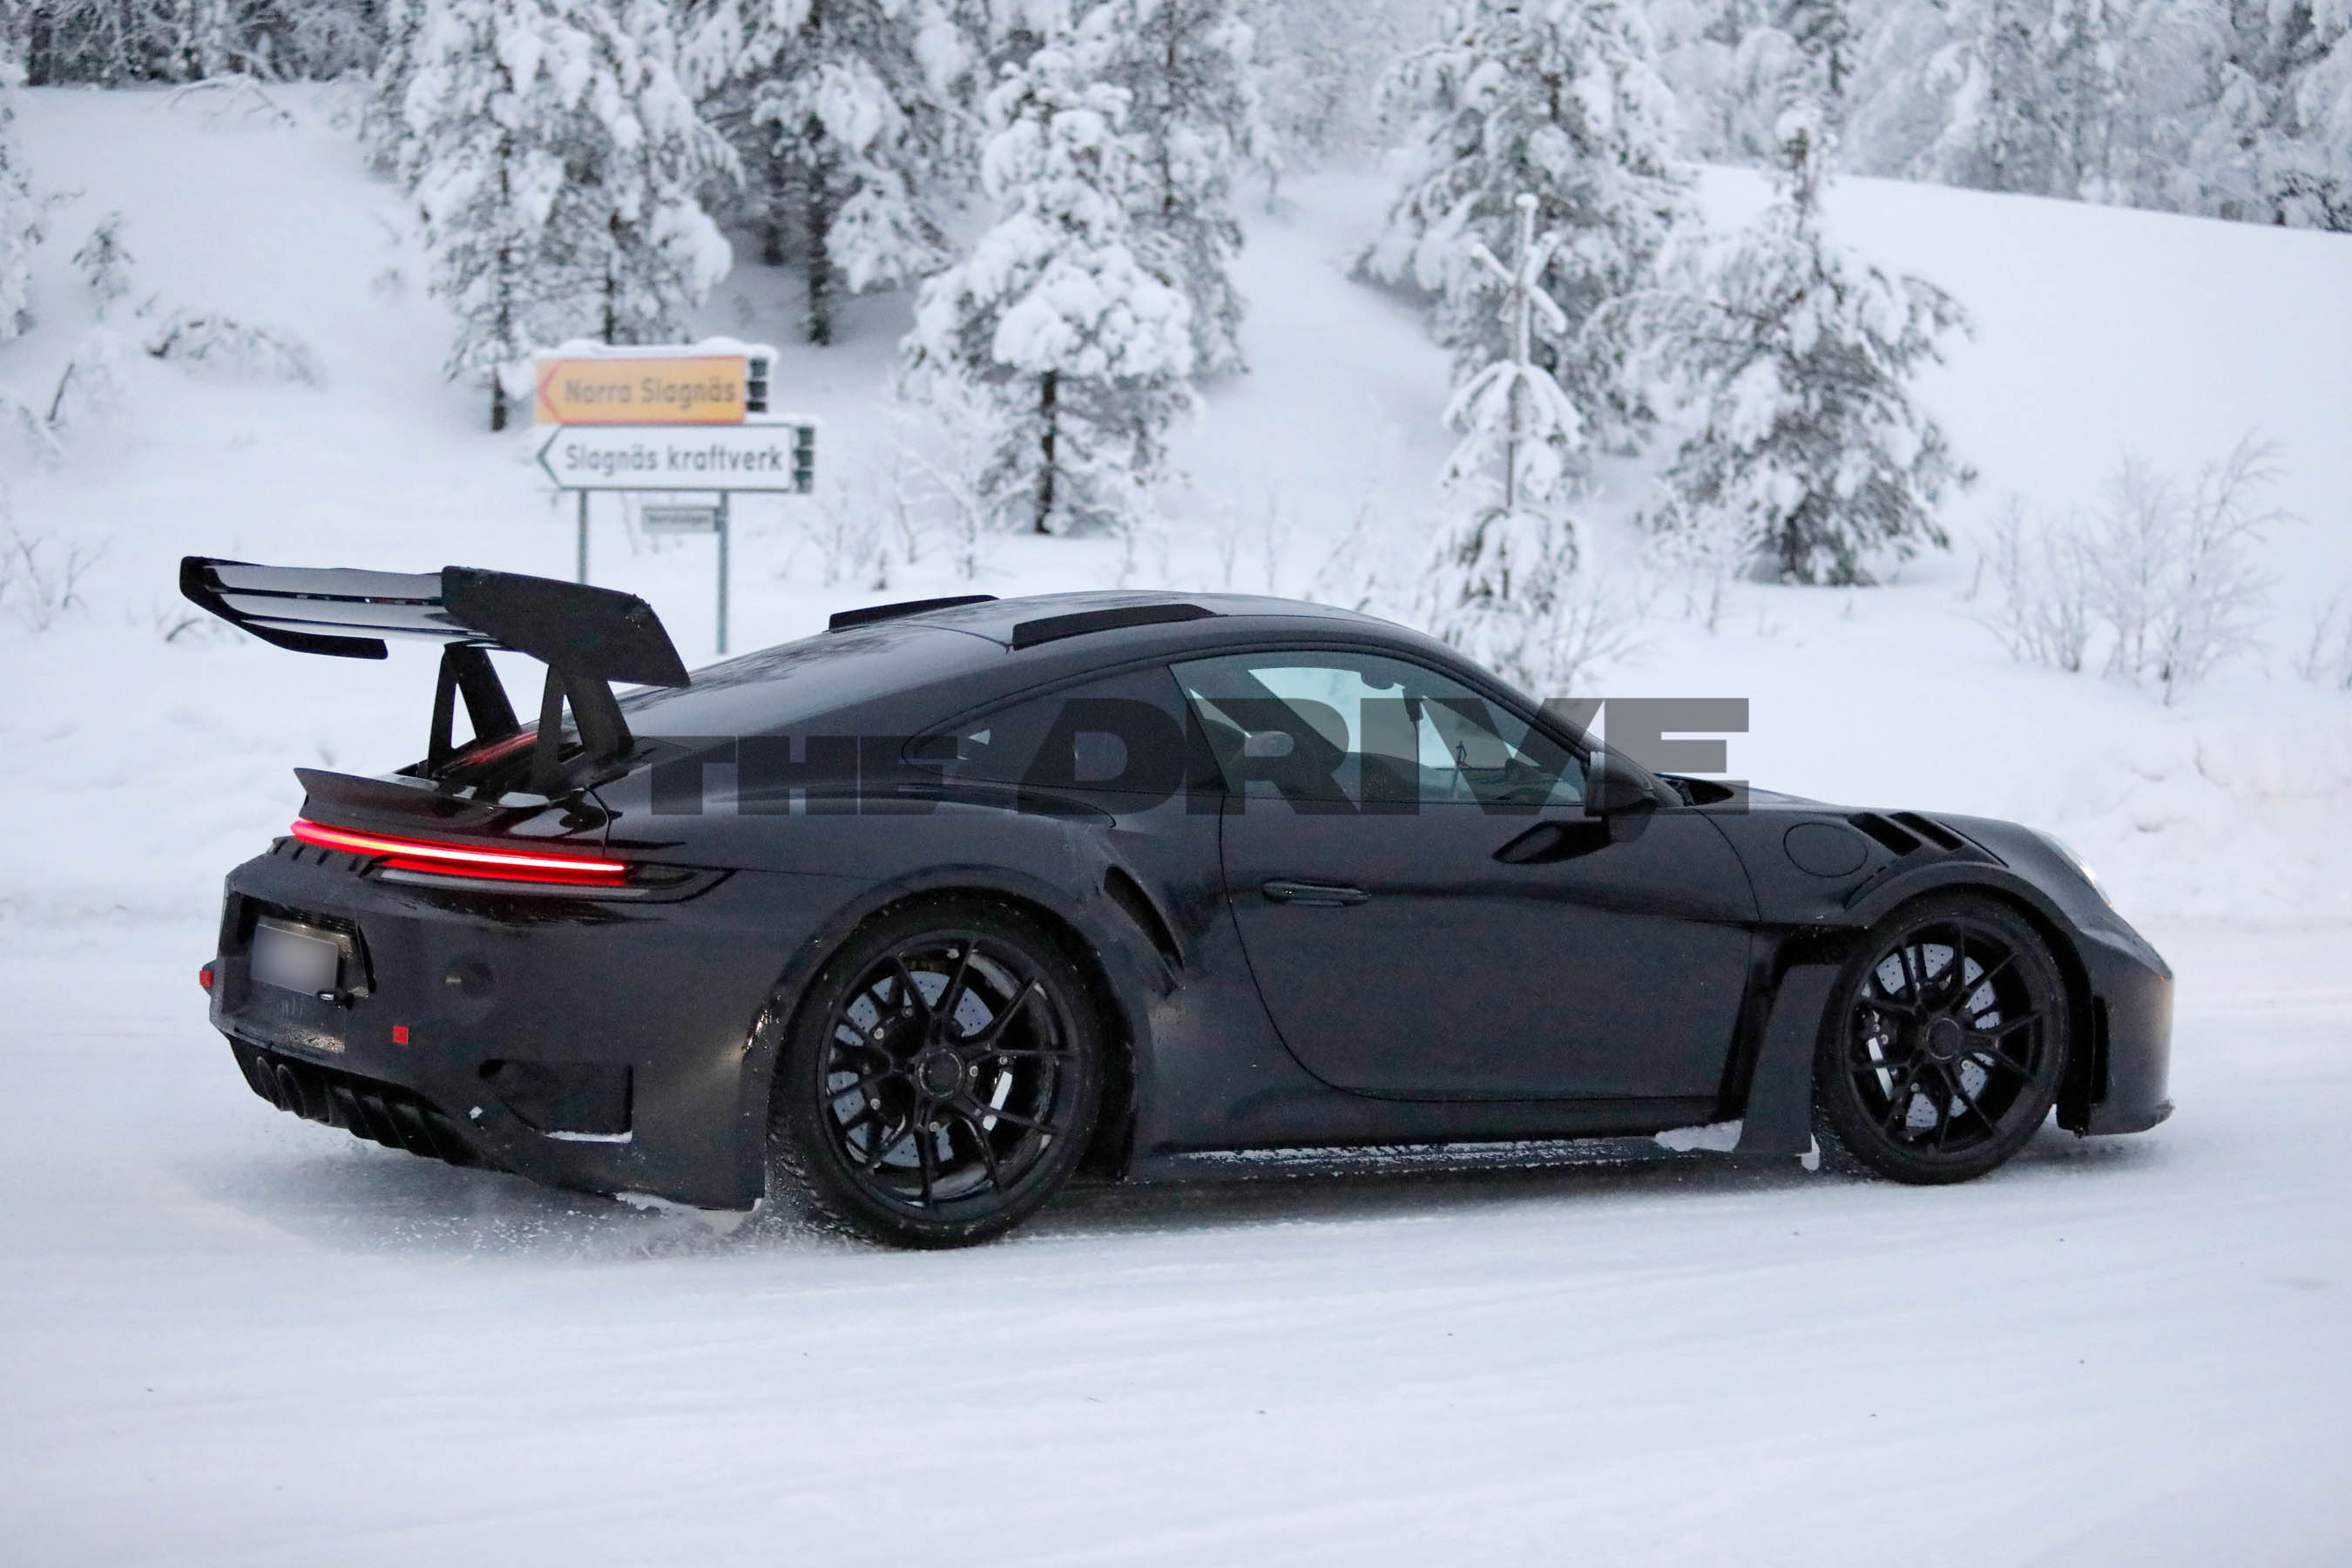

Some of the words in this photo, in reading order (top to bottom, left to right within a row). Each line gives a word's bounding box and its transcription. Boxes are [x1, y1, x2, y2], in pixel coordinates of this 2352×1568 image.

[564, 378, 632, 403] Norra
[640, 375, 737, 410] Slagnäs
[565, 443, 658, 477] Slagnäs
[667, 443, 783, 470] kraftverk
